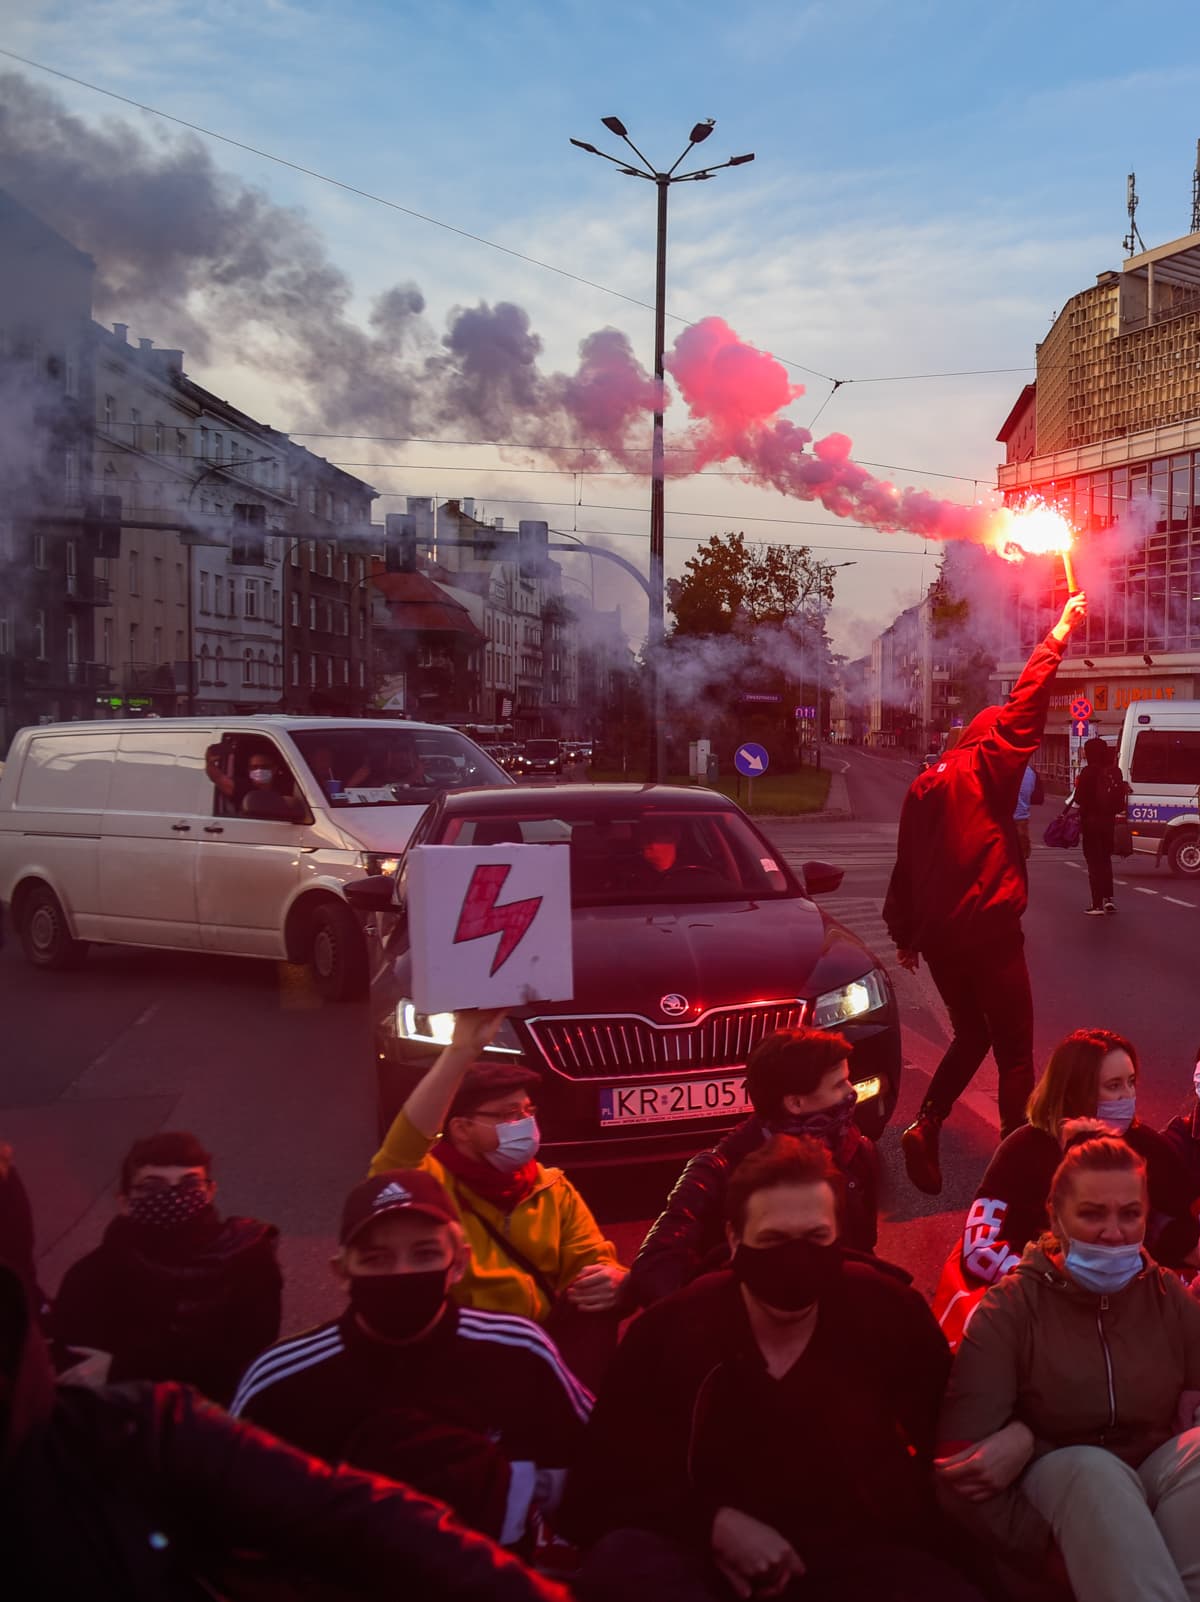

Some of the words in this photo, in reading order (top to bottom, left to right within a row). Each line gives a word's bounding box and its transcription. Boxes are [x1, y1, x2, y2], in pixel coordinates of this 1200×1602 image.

[1132, 807, 1158, 819] G731
[618, 1088, 659, 1116] KR
[669, 1080, 749, 1112] 2L051
[601, 1107, 612, 1117] PL
